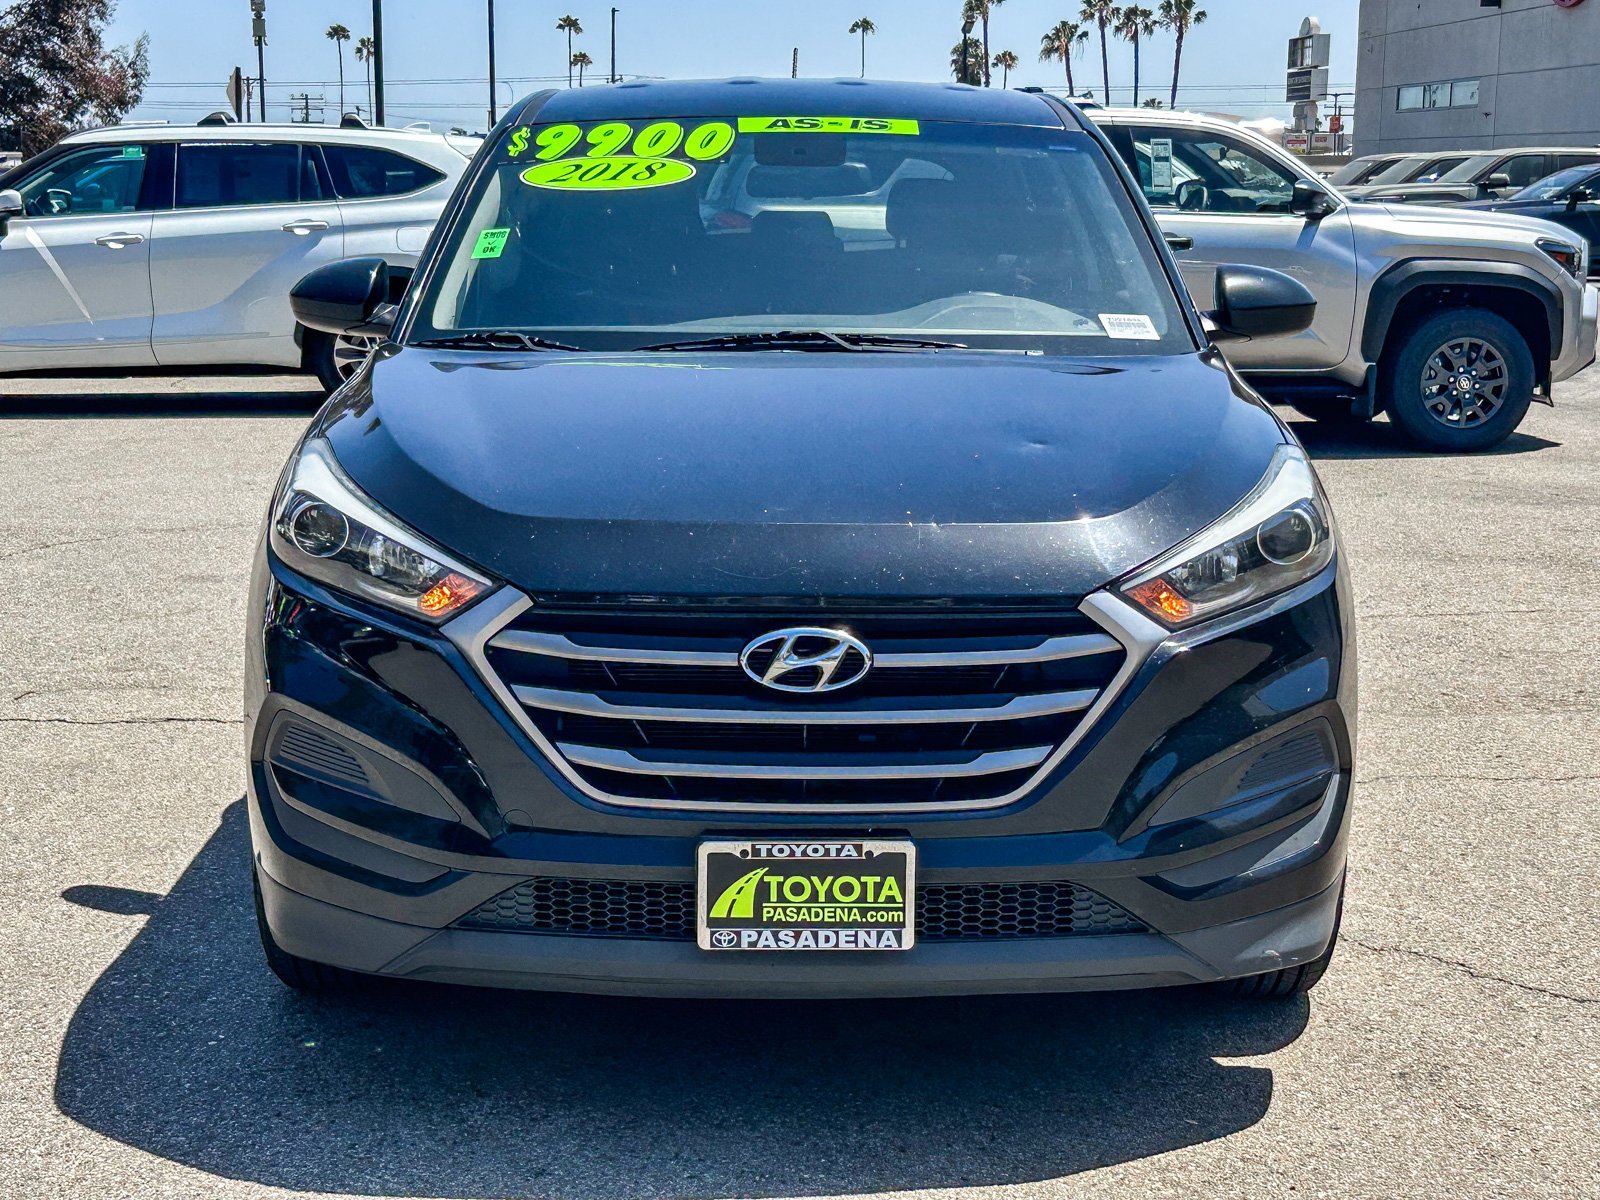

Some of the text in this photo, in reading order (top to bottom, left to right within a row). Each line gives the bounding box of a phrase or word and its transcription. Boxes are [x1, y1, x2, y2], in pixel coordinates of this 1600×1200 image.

[508, 122, 735, 161] $9900
[546, 162, 667, 183] 2018
[482, 245, 497, 254] OK
[755, 844, 858, 858] TOYOTA
[763, 875, 903, 903] TOYOTA
[762, 907, 904, 923] PASADENA.com
[740, 930, 900, 948] PASADENA
